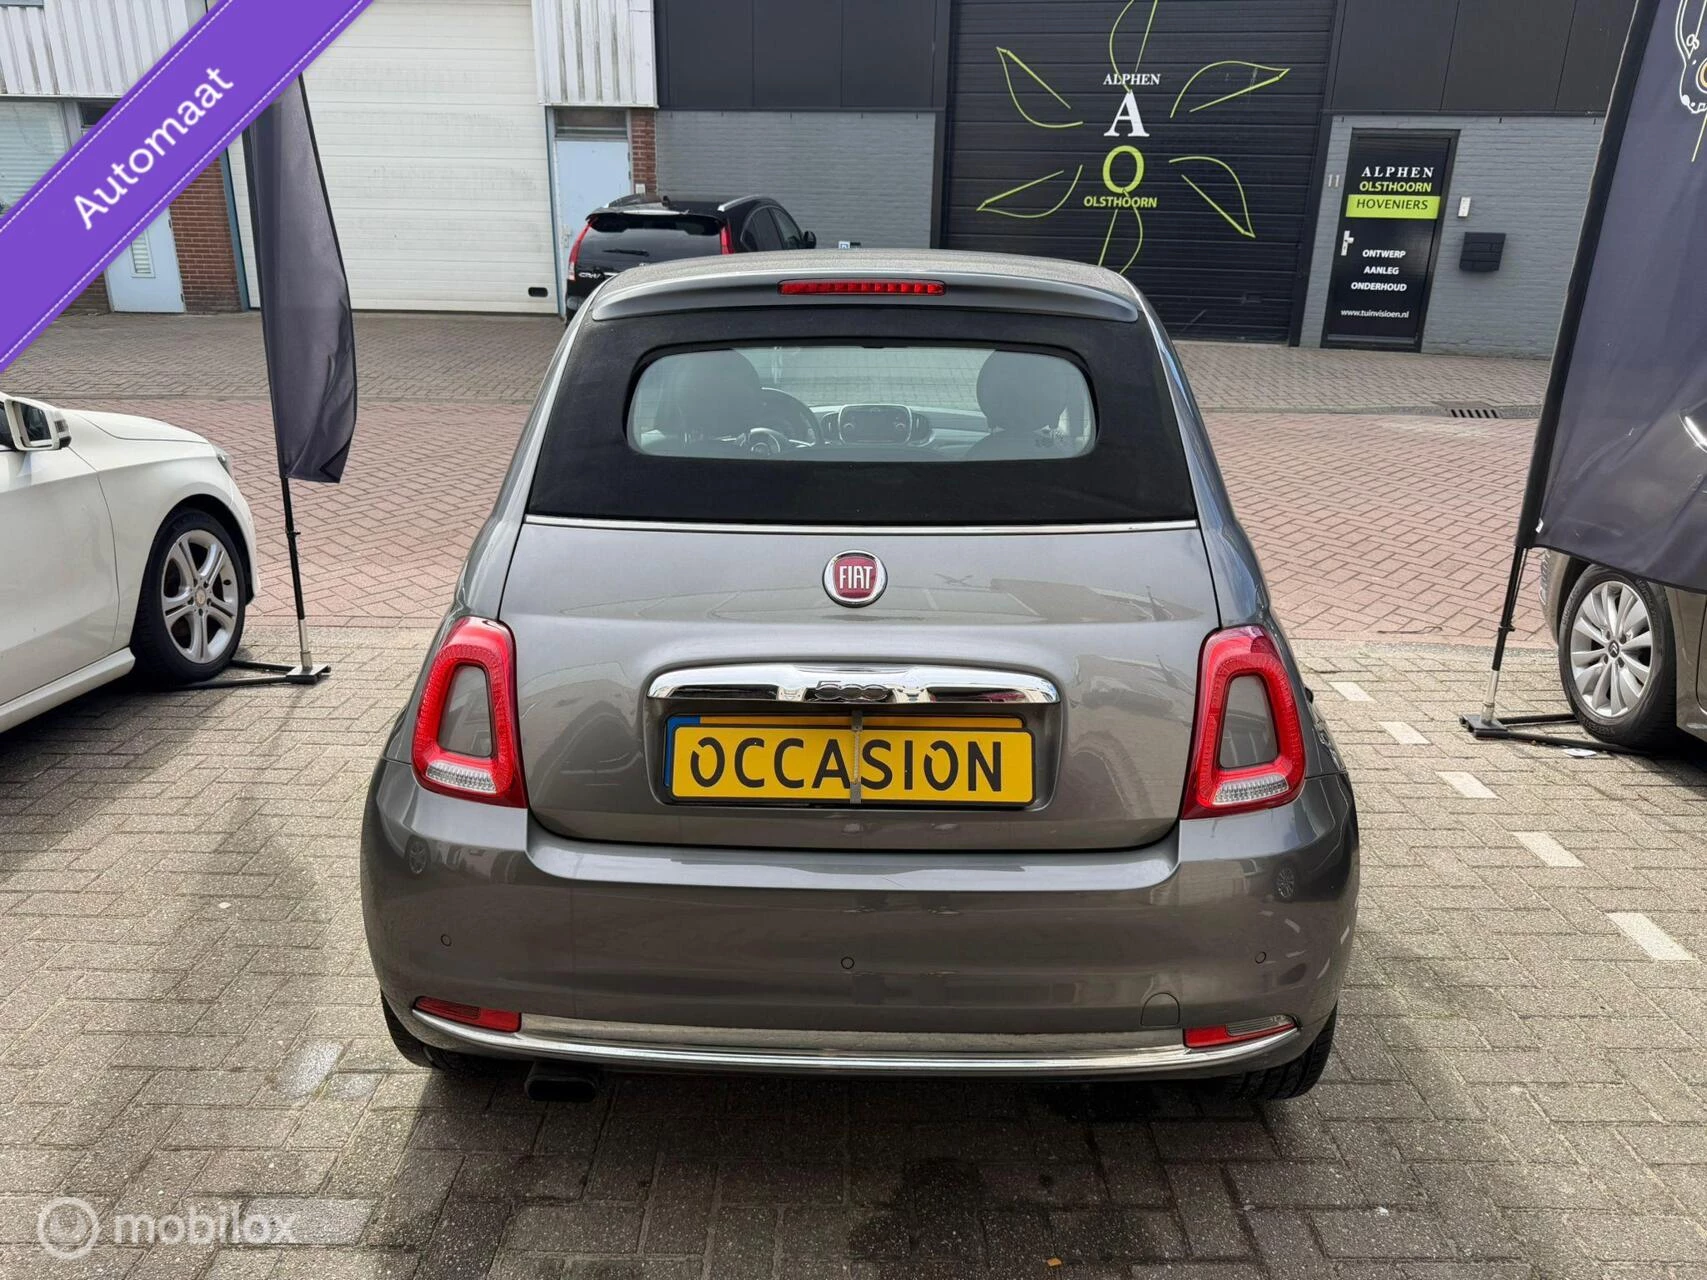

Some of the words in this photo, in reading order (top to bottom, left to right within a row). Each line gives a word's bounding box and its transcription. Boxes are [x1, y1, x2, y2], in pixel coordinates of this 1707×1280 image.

[1103, 73, 1161, 85] ALPHEN
[1104, 89, 1150, 137] A
[1103, 145, 1144, 193] O
[1361, 166, 1435, 178] ALPHEN
[1359, 181, 1432, 193] OLSTHOORN
[1083, 196, 1157, 208] OLSTHOORN
[1356, 198, 1428, 210] HOVENIERS
[1362, 249, 1406, 258] ONTWERP
[1363, 266, 1399, 275] AANLEG
[1351, 281, 1407, 291] ONDERHOUD
[1340, 309, 1409, 318] www.tuinvisioen.nl
[839, 565, 873, 590] FIAT
[690, 736, 1002, 792] OCCASION
